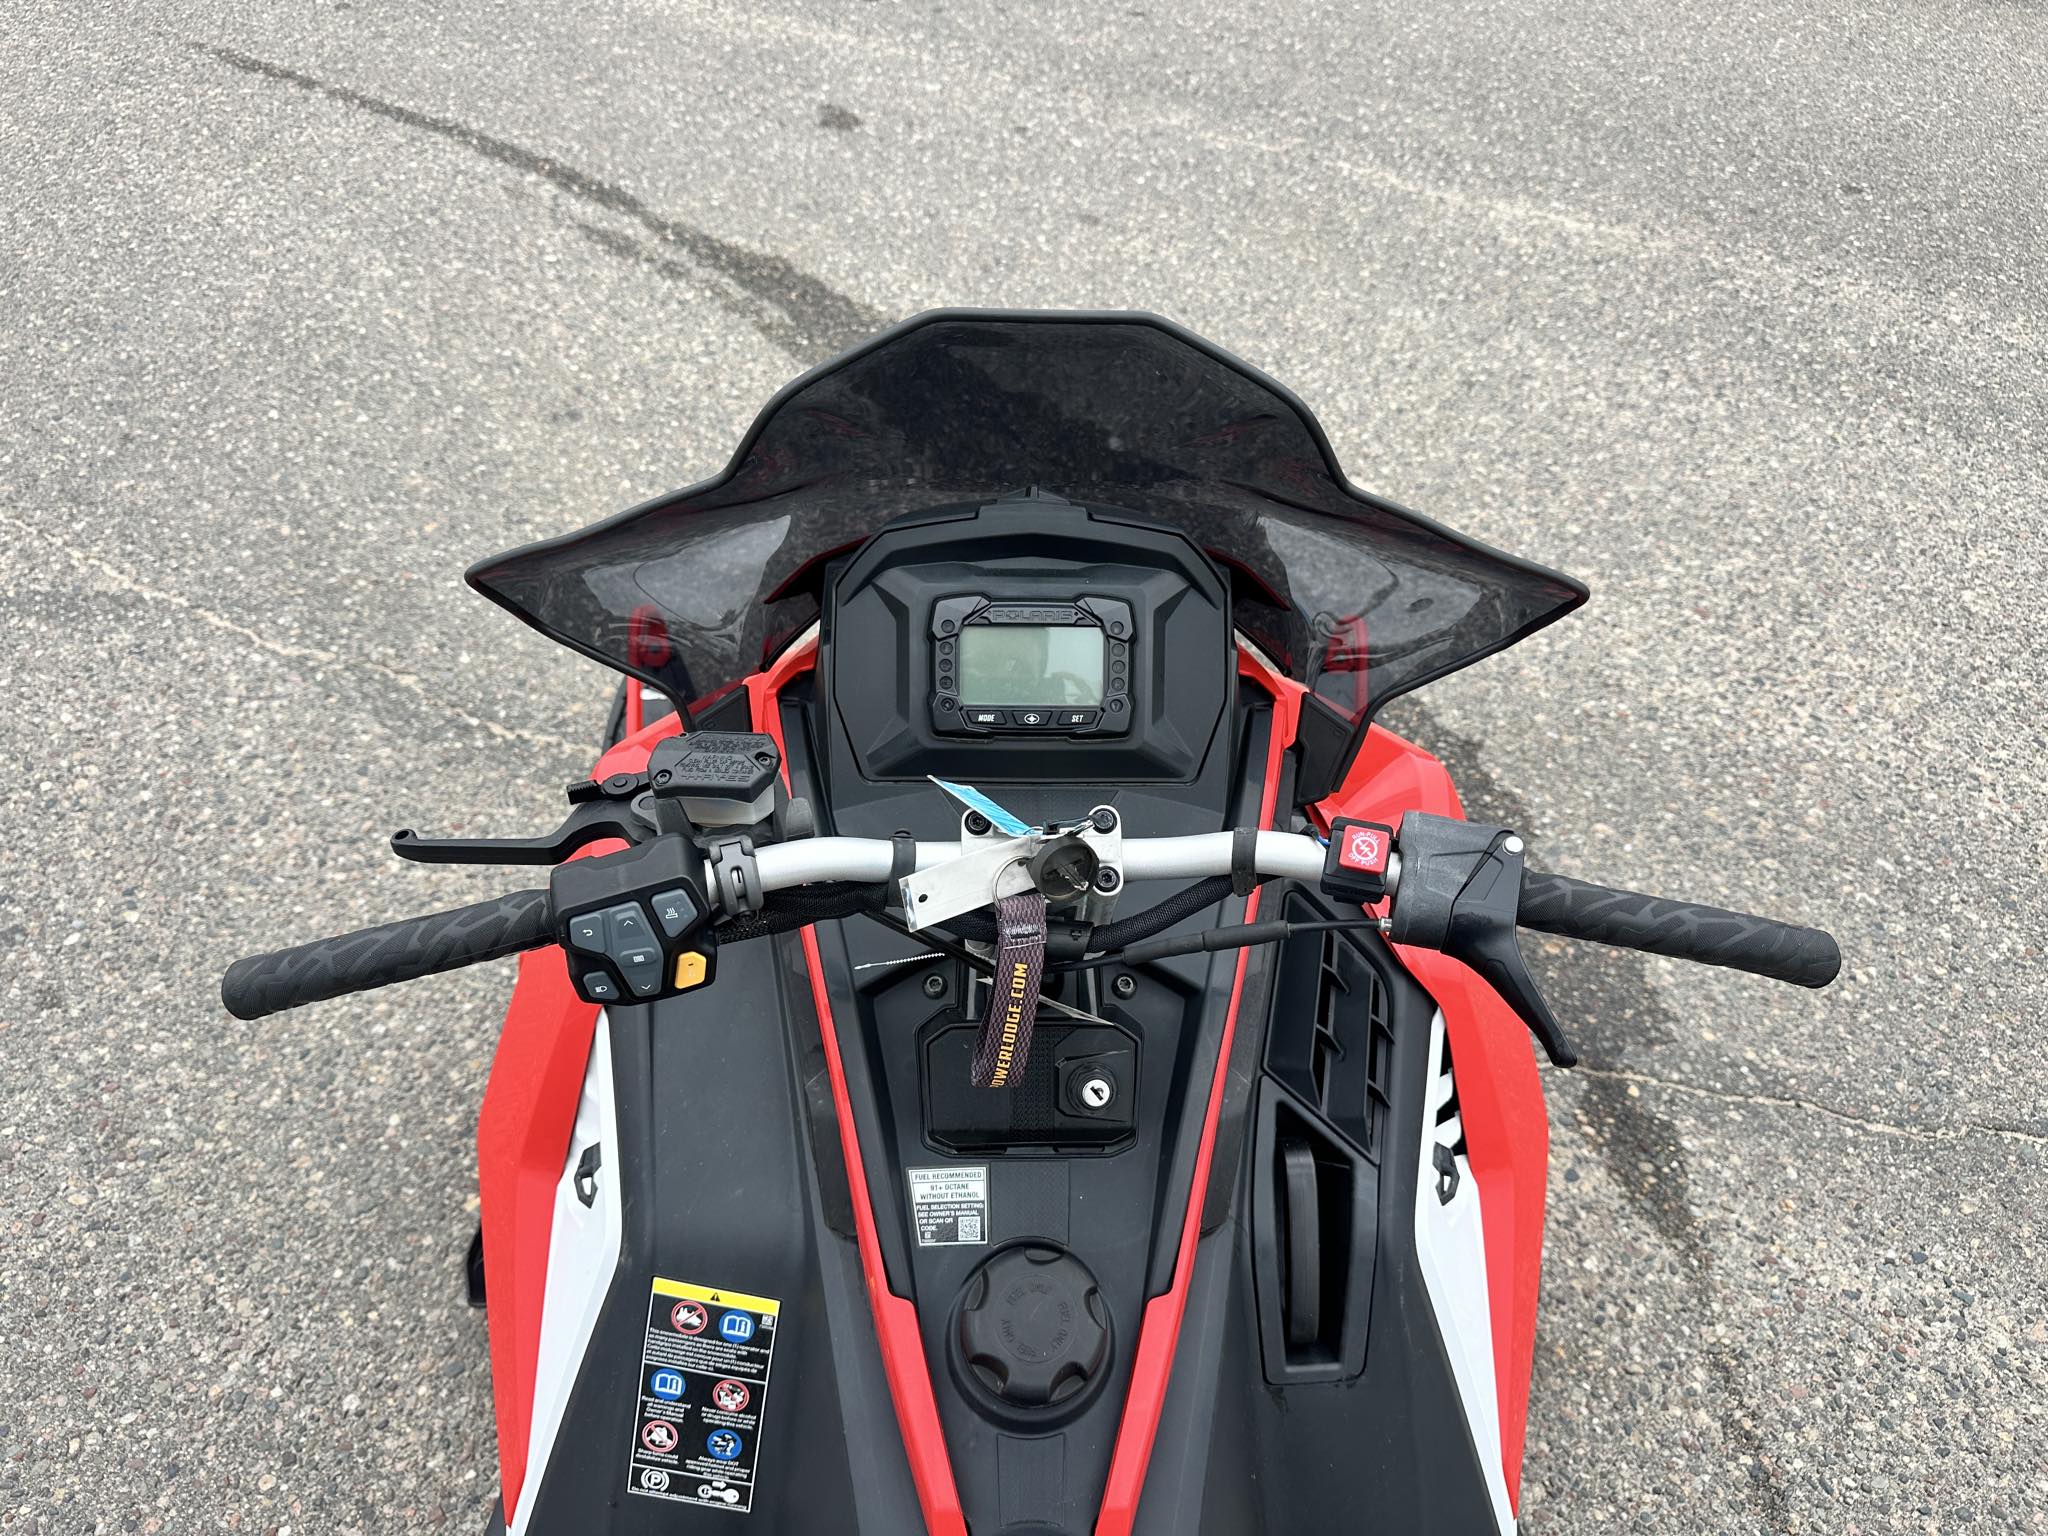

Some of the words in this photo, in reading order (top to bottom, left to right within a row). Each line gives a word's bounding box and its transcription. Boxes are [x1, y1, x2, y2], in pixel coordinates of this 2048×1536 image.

[992, 609, 1073, 620] POLARIS
[978, 714, 995, 722] MODE
[1072, 714, 1084, 722] SET
[990, 962, 1028, 1087] OWERLODGE.COM
[932, 1172, 982, 1180] RECOMMENDED
